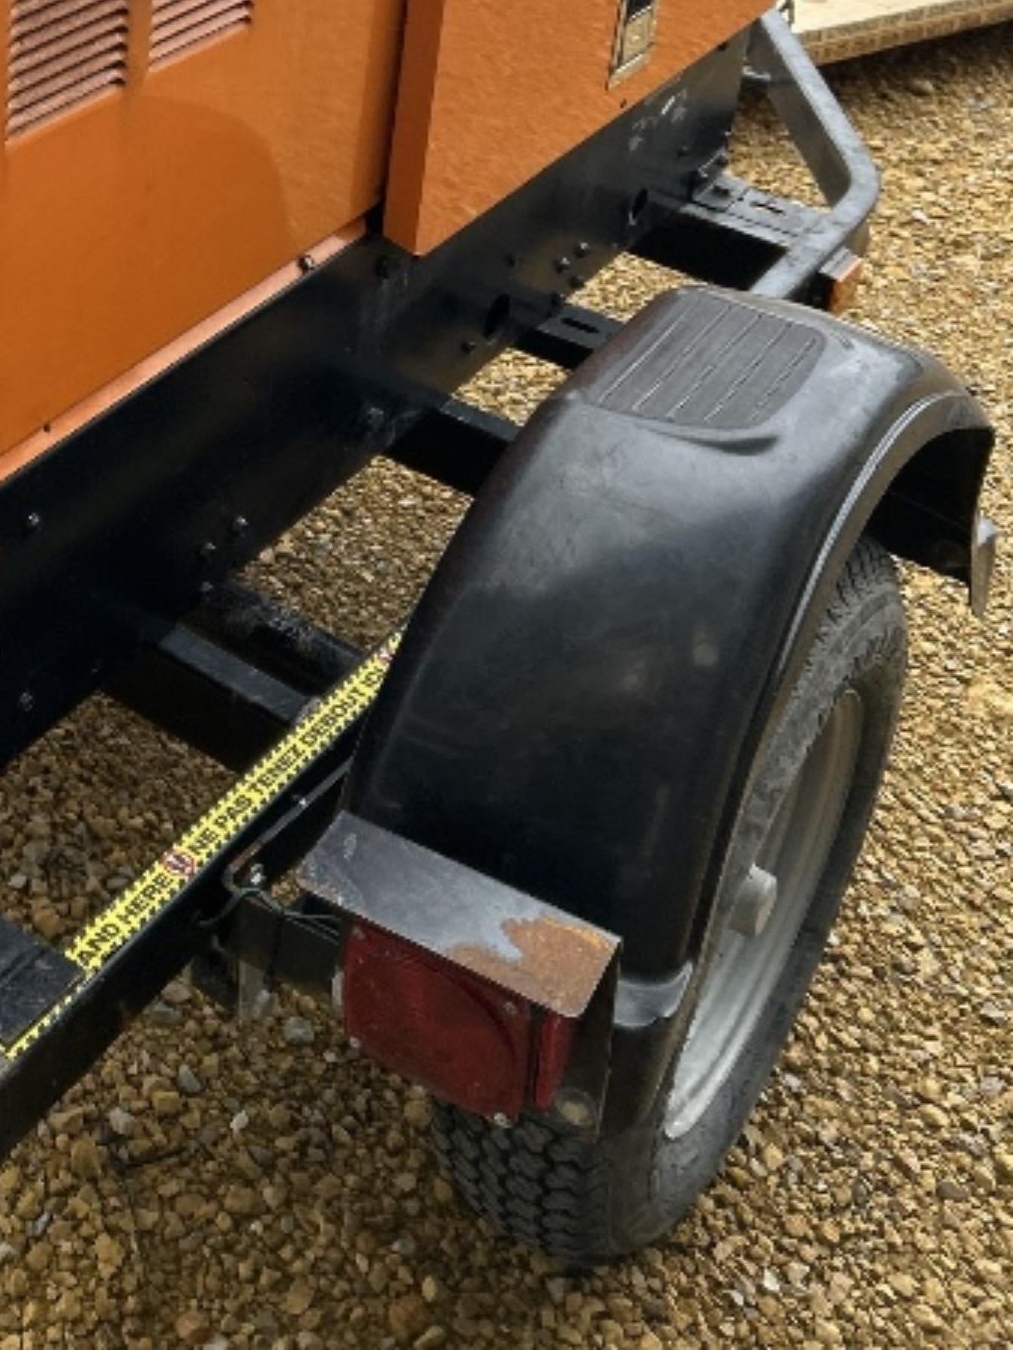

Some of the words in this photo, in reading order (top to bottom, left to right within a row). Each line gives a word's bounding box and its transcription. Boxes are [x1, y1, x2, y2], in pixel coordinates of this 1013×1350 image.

[188, 827, 220, 855] NE
[214, 794, 253, 828] PAS
[249, 744, 304, 796] TENEZ
[300, 686, 366, 747] DEBOUT
[116, 872, 173, 923] HERE
